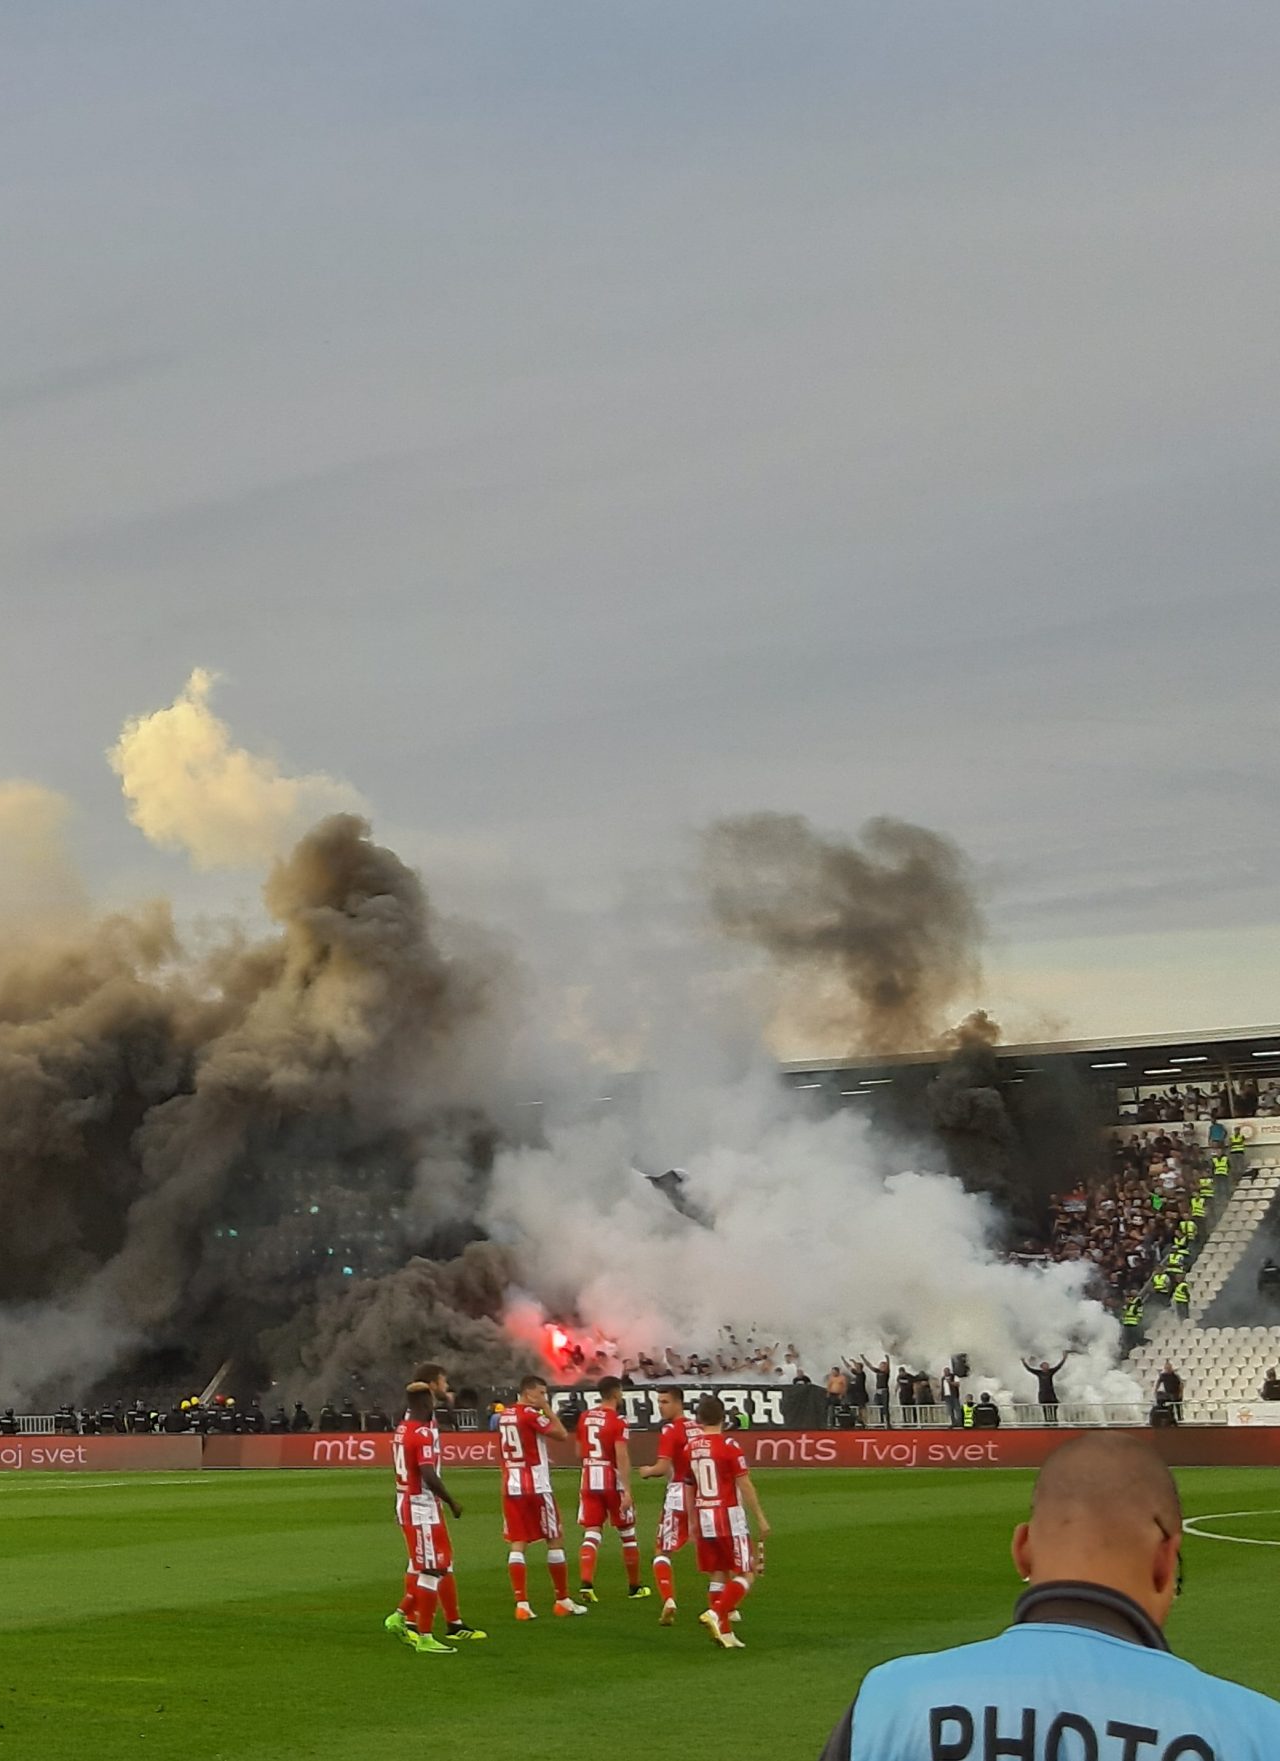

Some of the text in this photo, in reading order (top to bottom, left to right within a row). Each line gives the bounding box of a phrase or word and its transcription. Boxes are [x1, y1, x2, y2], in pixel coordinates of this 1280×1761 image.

[31, 1445, 87, 1464] svet
[313, 1435, 496, 1461] mts svet
[588, 1426, 602, 1458] 5
[755, 1434, 999, 1467] mts Tvoj svet
[691, 1458, 718, 1497] 10
